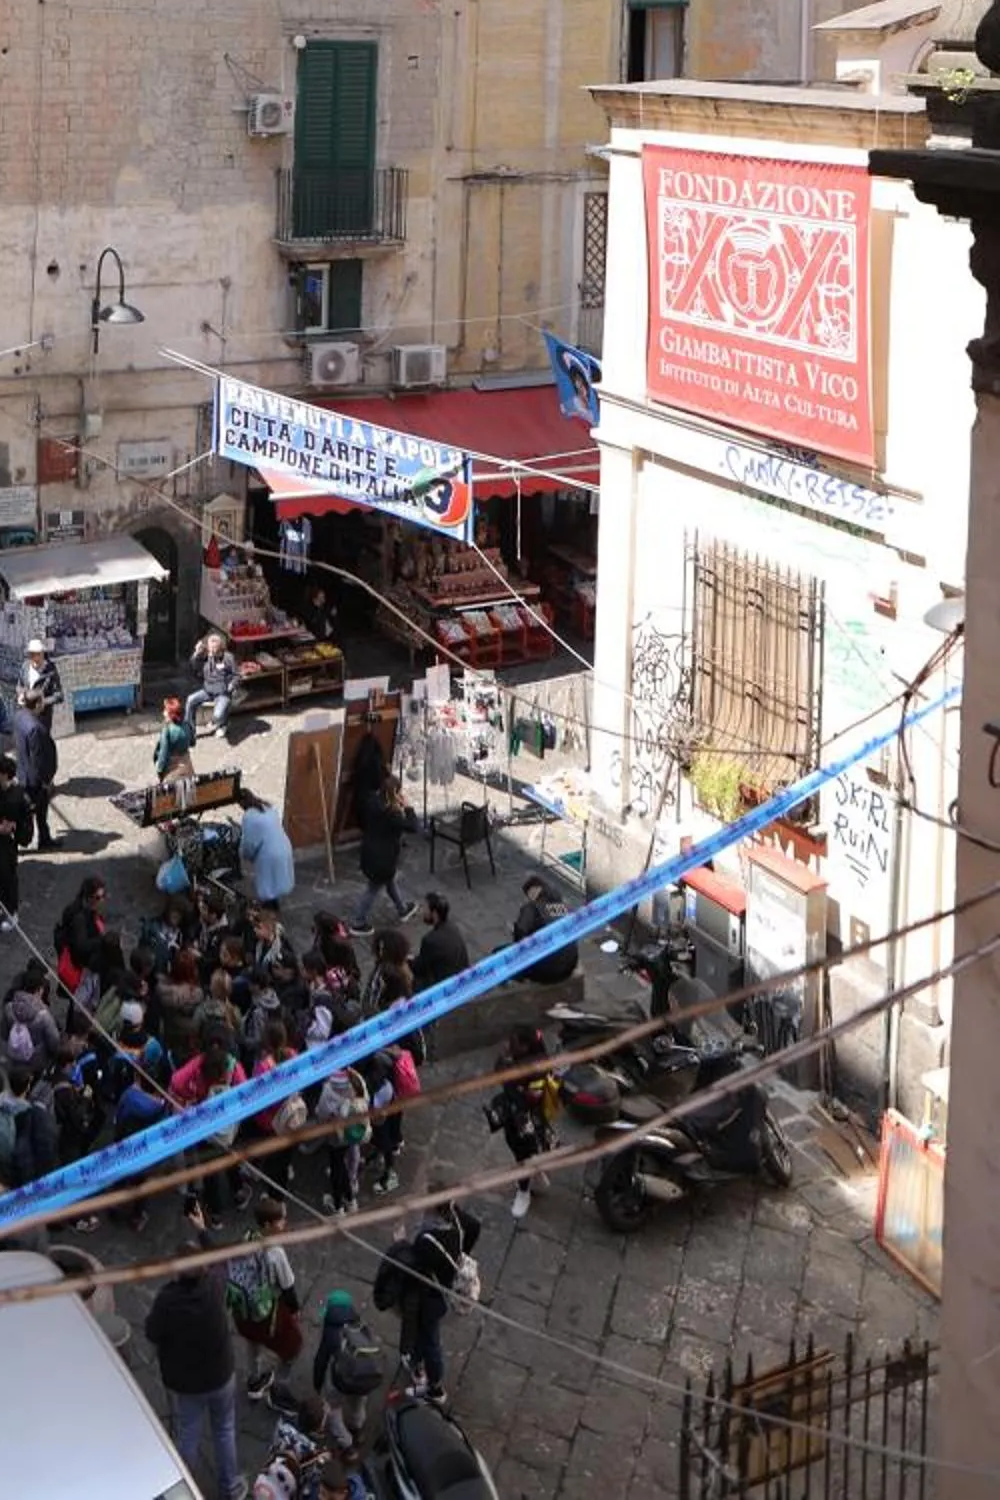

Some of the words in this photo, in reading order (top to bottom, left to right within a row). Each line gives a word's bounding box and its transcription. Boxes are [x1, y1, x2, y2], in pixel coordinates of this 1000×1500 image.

[658, 168, 856, 221] FONDAZIONE
[659, 326, 799, 388] GIAMBATTISTA
[803, 361, 859, 403] VICO
[226, 384, 345, 438] BENVENUTI
[743, 381, 780, 410] ALTA
[783, 393, 859, 431] CULTURA
[225, 428, 324, 478] CAMPIONE
